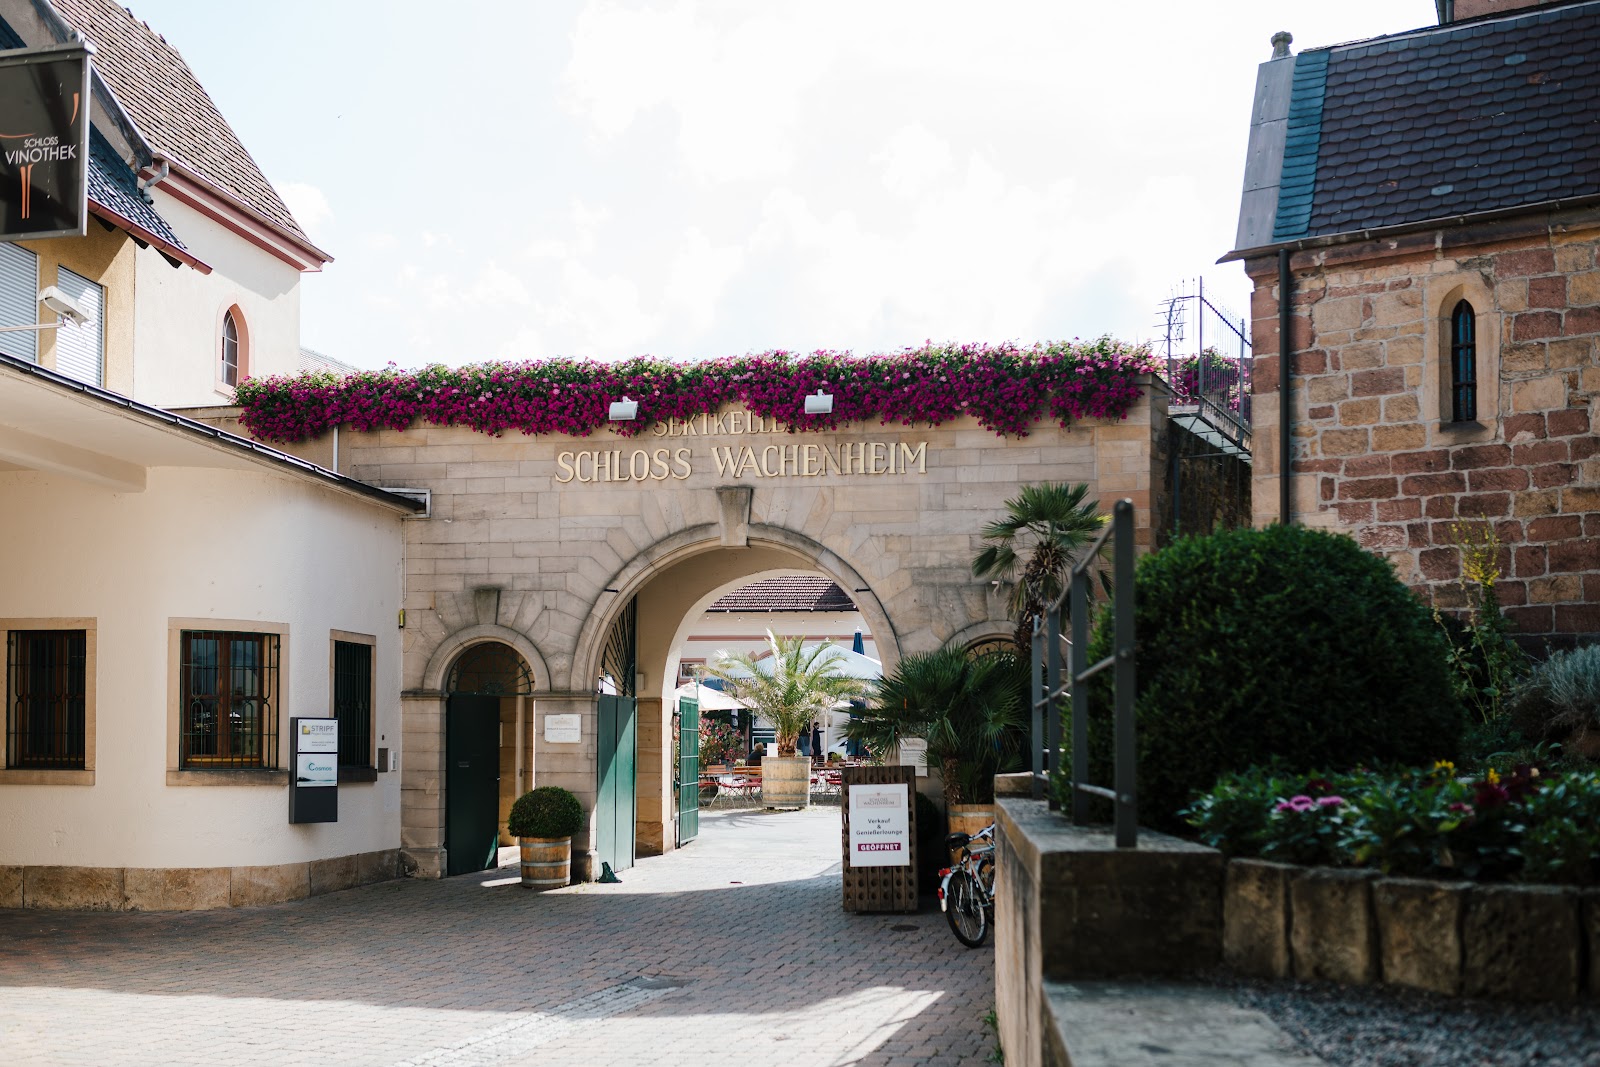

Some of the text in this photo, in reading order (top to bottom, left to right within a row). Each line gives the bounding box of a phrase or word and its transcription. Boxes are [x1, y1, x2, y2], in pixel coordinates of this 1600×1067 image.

[24, 136, 58, 148] SCHLOSS
[5, 144, 76, 165] VINOTHEK
[554, 441, 928, 482] SCHLOSS WACHENHEIM
[308, 762, 332, 771] Cosmos
[860, 843, 899, 851] GEÖFFNET
